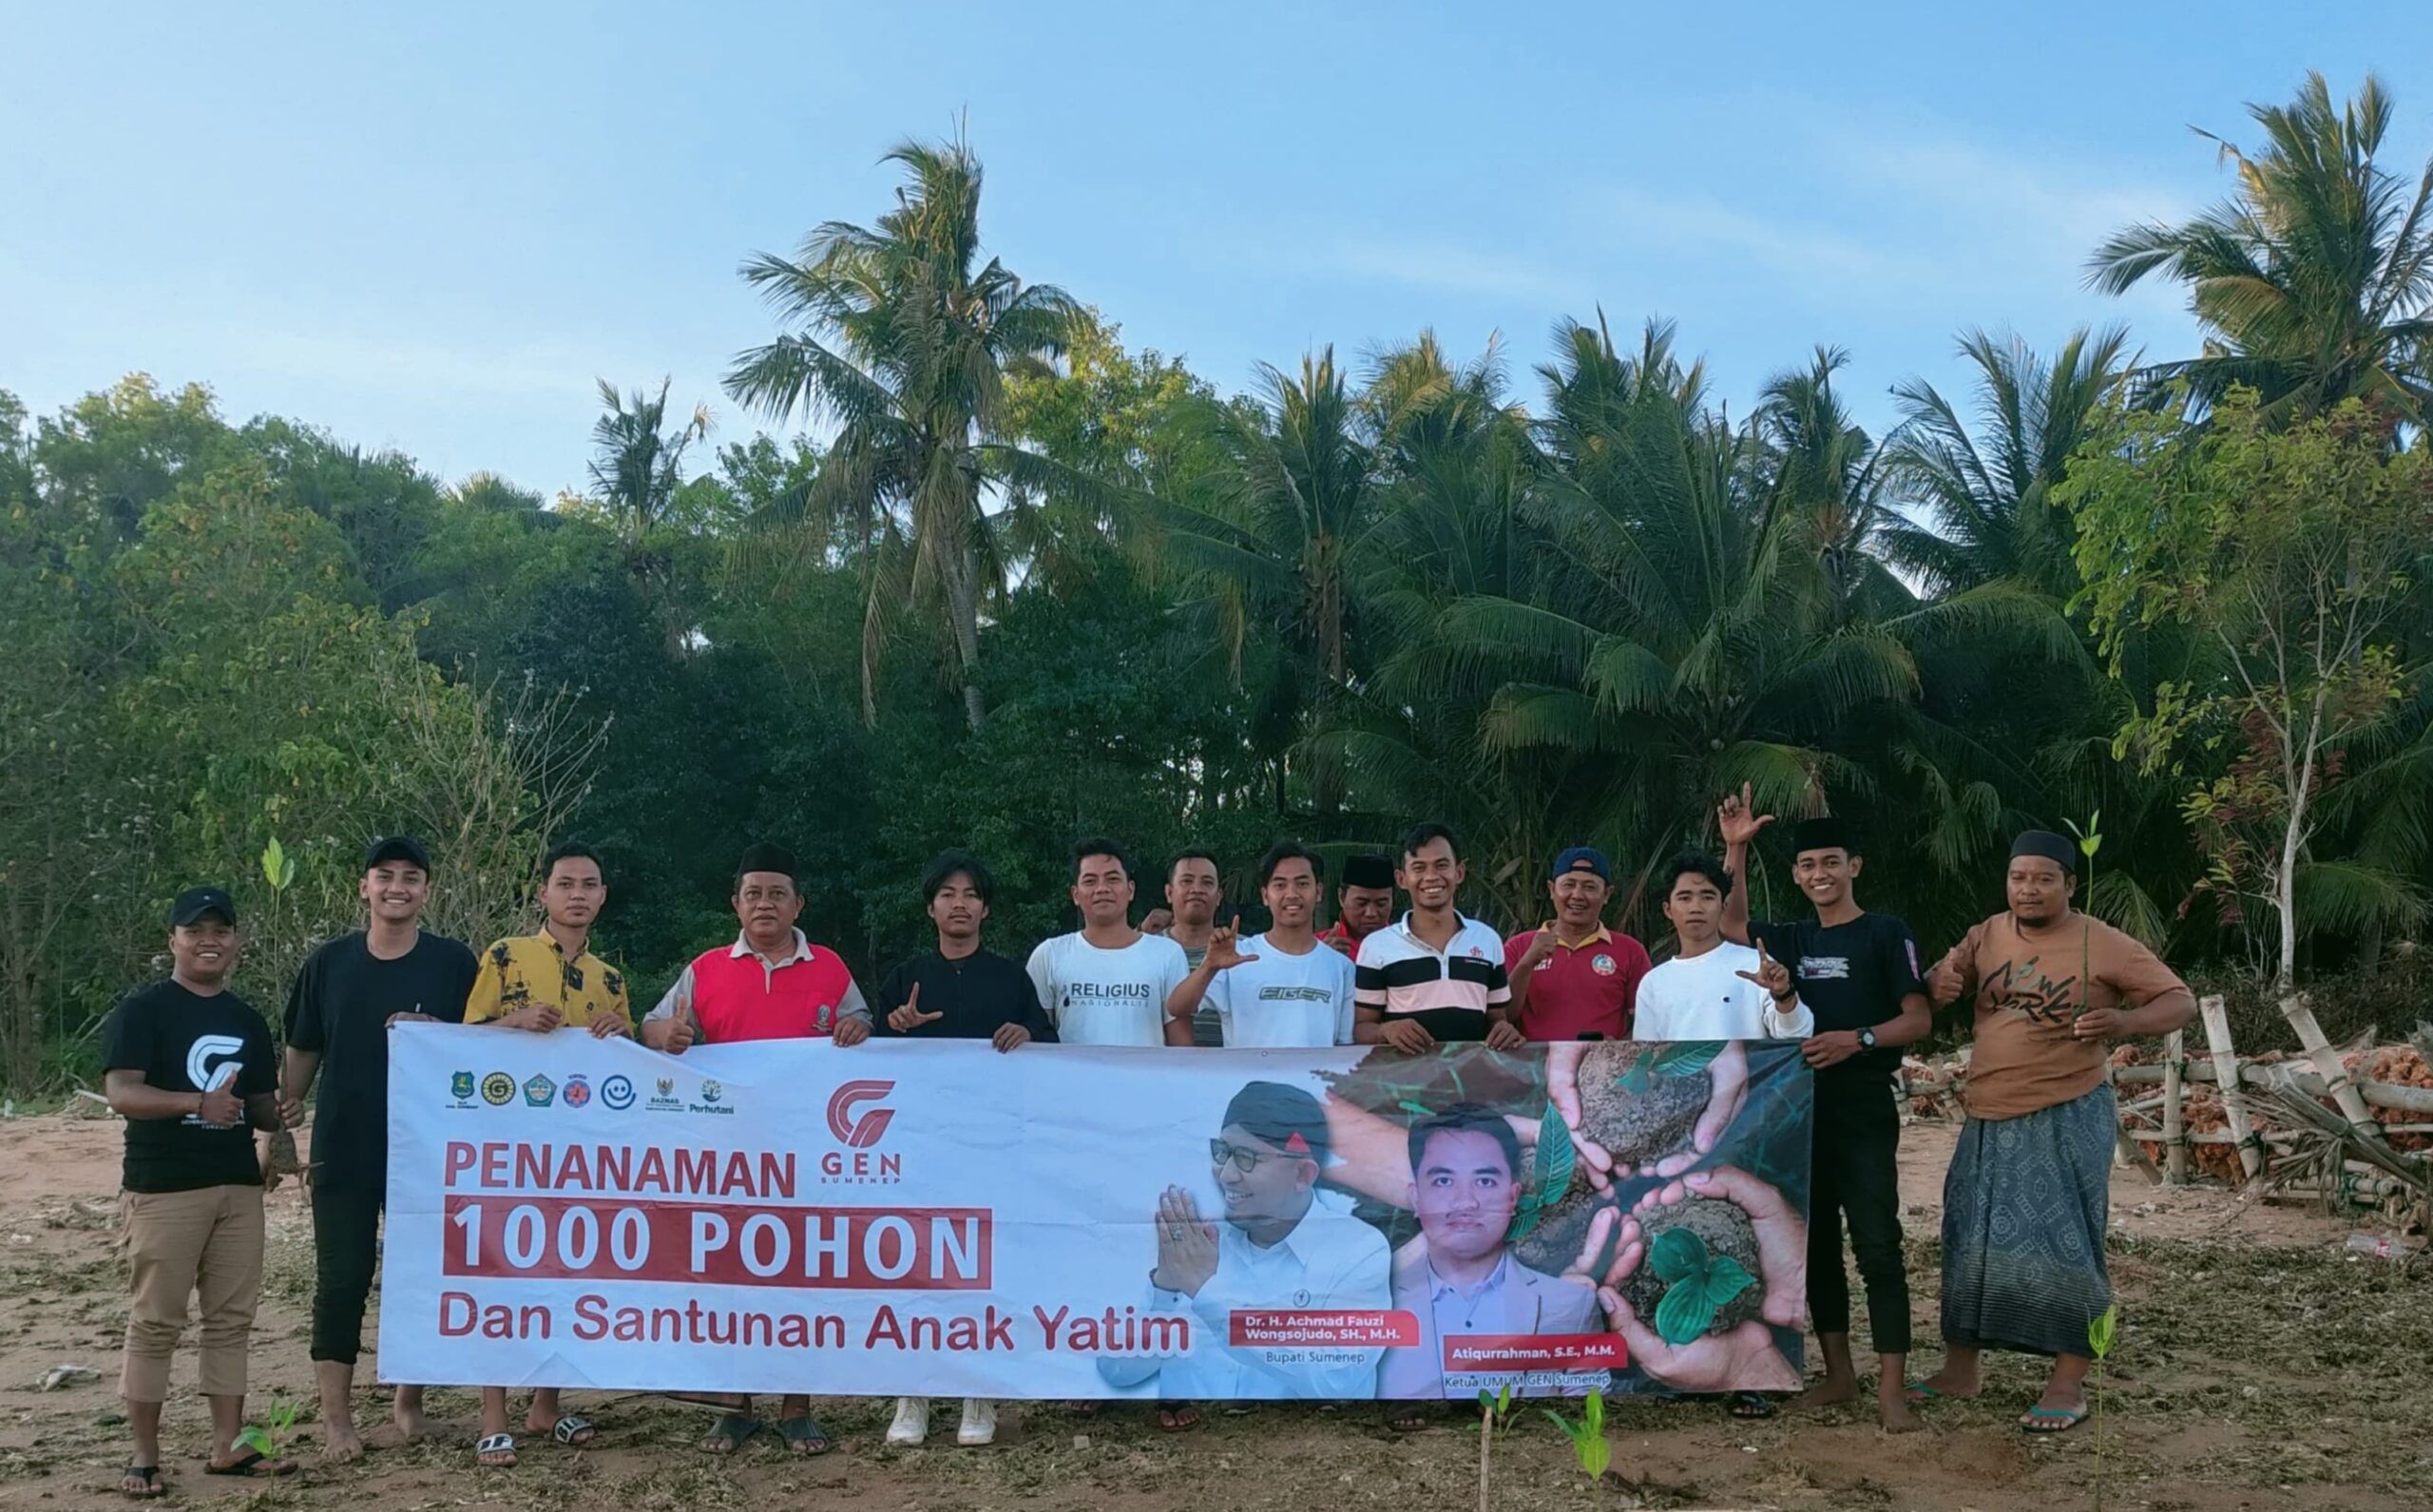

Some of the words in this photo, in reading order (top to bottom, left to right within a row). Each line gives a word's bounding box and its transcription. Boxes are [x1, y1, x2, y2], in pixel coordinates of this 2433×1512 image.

[1071, 983, 1150, 998] RELIGIUS
[1259, 986, 1331, 1004] EIGER
[689, 1103, 734, 1114] Perhutani
[444, 1140, 796, 1198] PENANAMAN
[821, 1152, 901, 1176] GEN
[452, 1203, 651, 1272] 1000
[691, 1211, 980, 1280] POHON
[438, 1291, 551, 1339] Dan
[572, 1294, 845, 1349] Santunan
[865, 1305, 1014, 1350] Anak
[1033, 1305, 1189, 1351] Yatim
[1245, 1316, 1265, 1327] Dr.
[1269, 1316, 1283, 1327] H.
[1287, 1315, 1344, 1327] Achmad
[1348, 1315, 1384, 1327] Fauzi
[1245, 1328, 1336, 1342] Wongsojudo,
[1340, 1329, 1366, 1341] SH.,
[1370, 1329, 1401, 1340] M.H.
[1266, 1352, 1305, 1364] Bupati
[1310, 1353, 1365, 1364] Sumenep
[1452, 1348, 1551, 1361] Atiqurrahman,
[1554, 1348, 1581, 1358] S.E.,
[1584, 1345, 1616, 1356] M.M.
[1445, 1377, 1479, 1388] Ketua
[1483, 1376, 1523, 1387] UMUM
[1527, 1373, 1553, 1386] GEN
[1556, 1373, 1612, 1387] Sumenep
